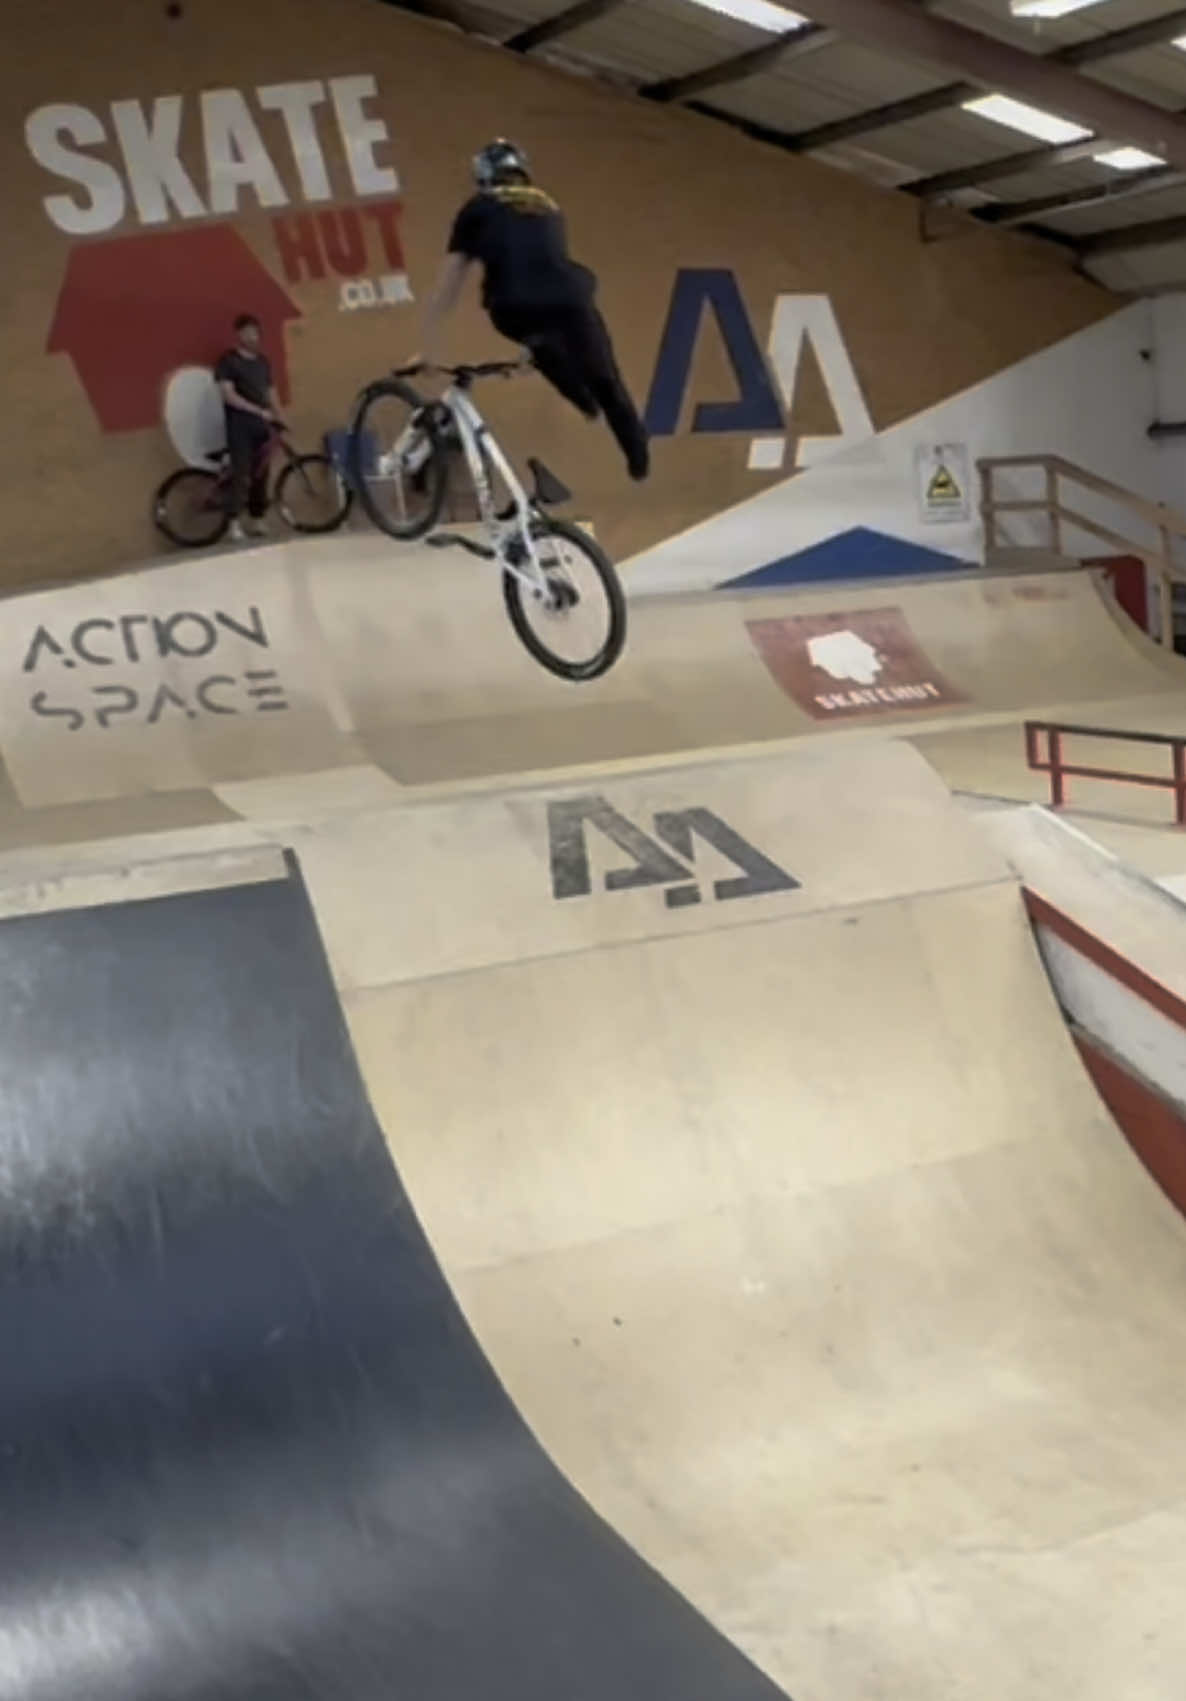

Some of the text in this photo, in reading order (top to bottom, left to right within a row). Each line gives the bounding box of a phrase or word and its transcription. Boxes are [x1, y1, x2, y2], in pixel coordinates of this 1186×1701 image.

[24, 74, 401, 235] SKATE
[271, 202, 407, 282] HUT
[22, 605, 270, 673] ACTION
[30, 668, 289, 732] SPACE
[813, 681, 941, 711] SKATEHUT
